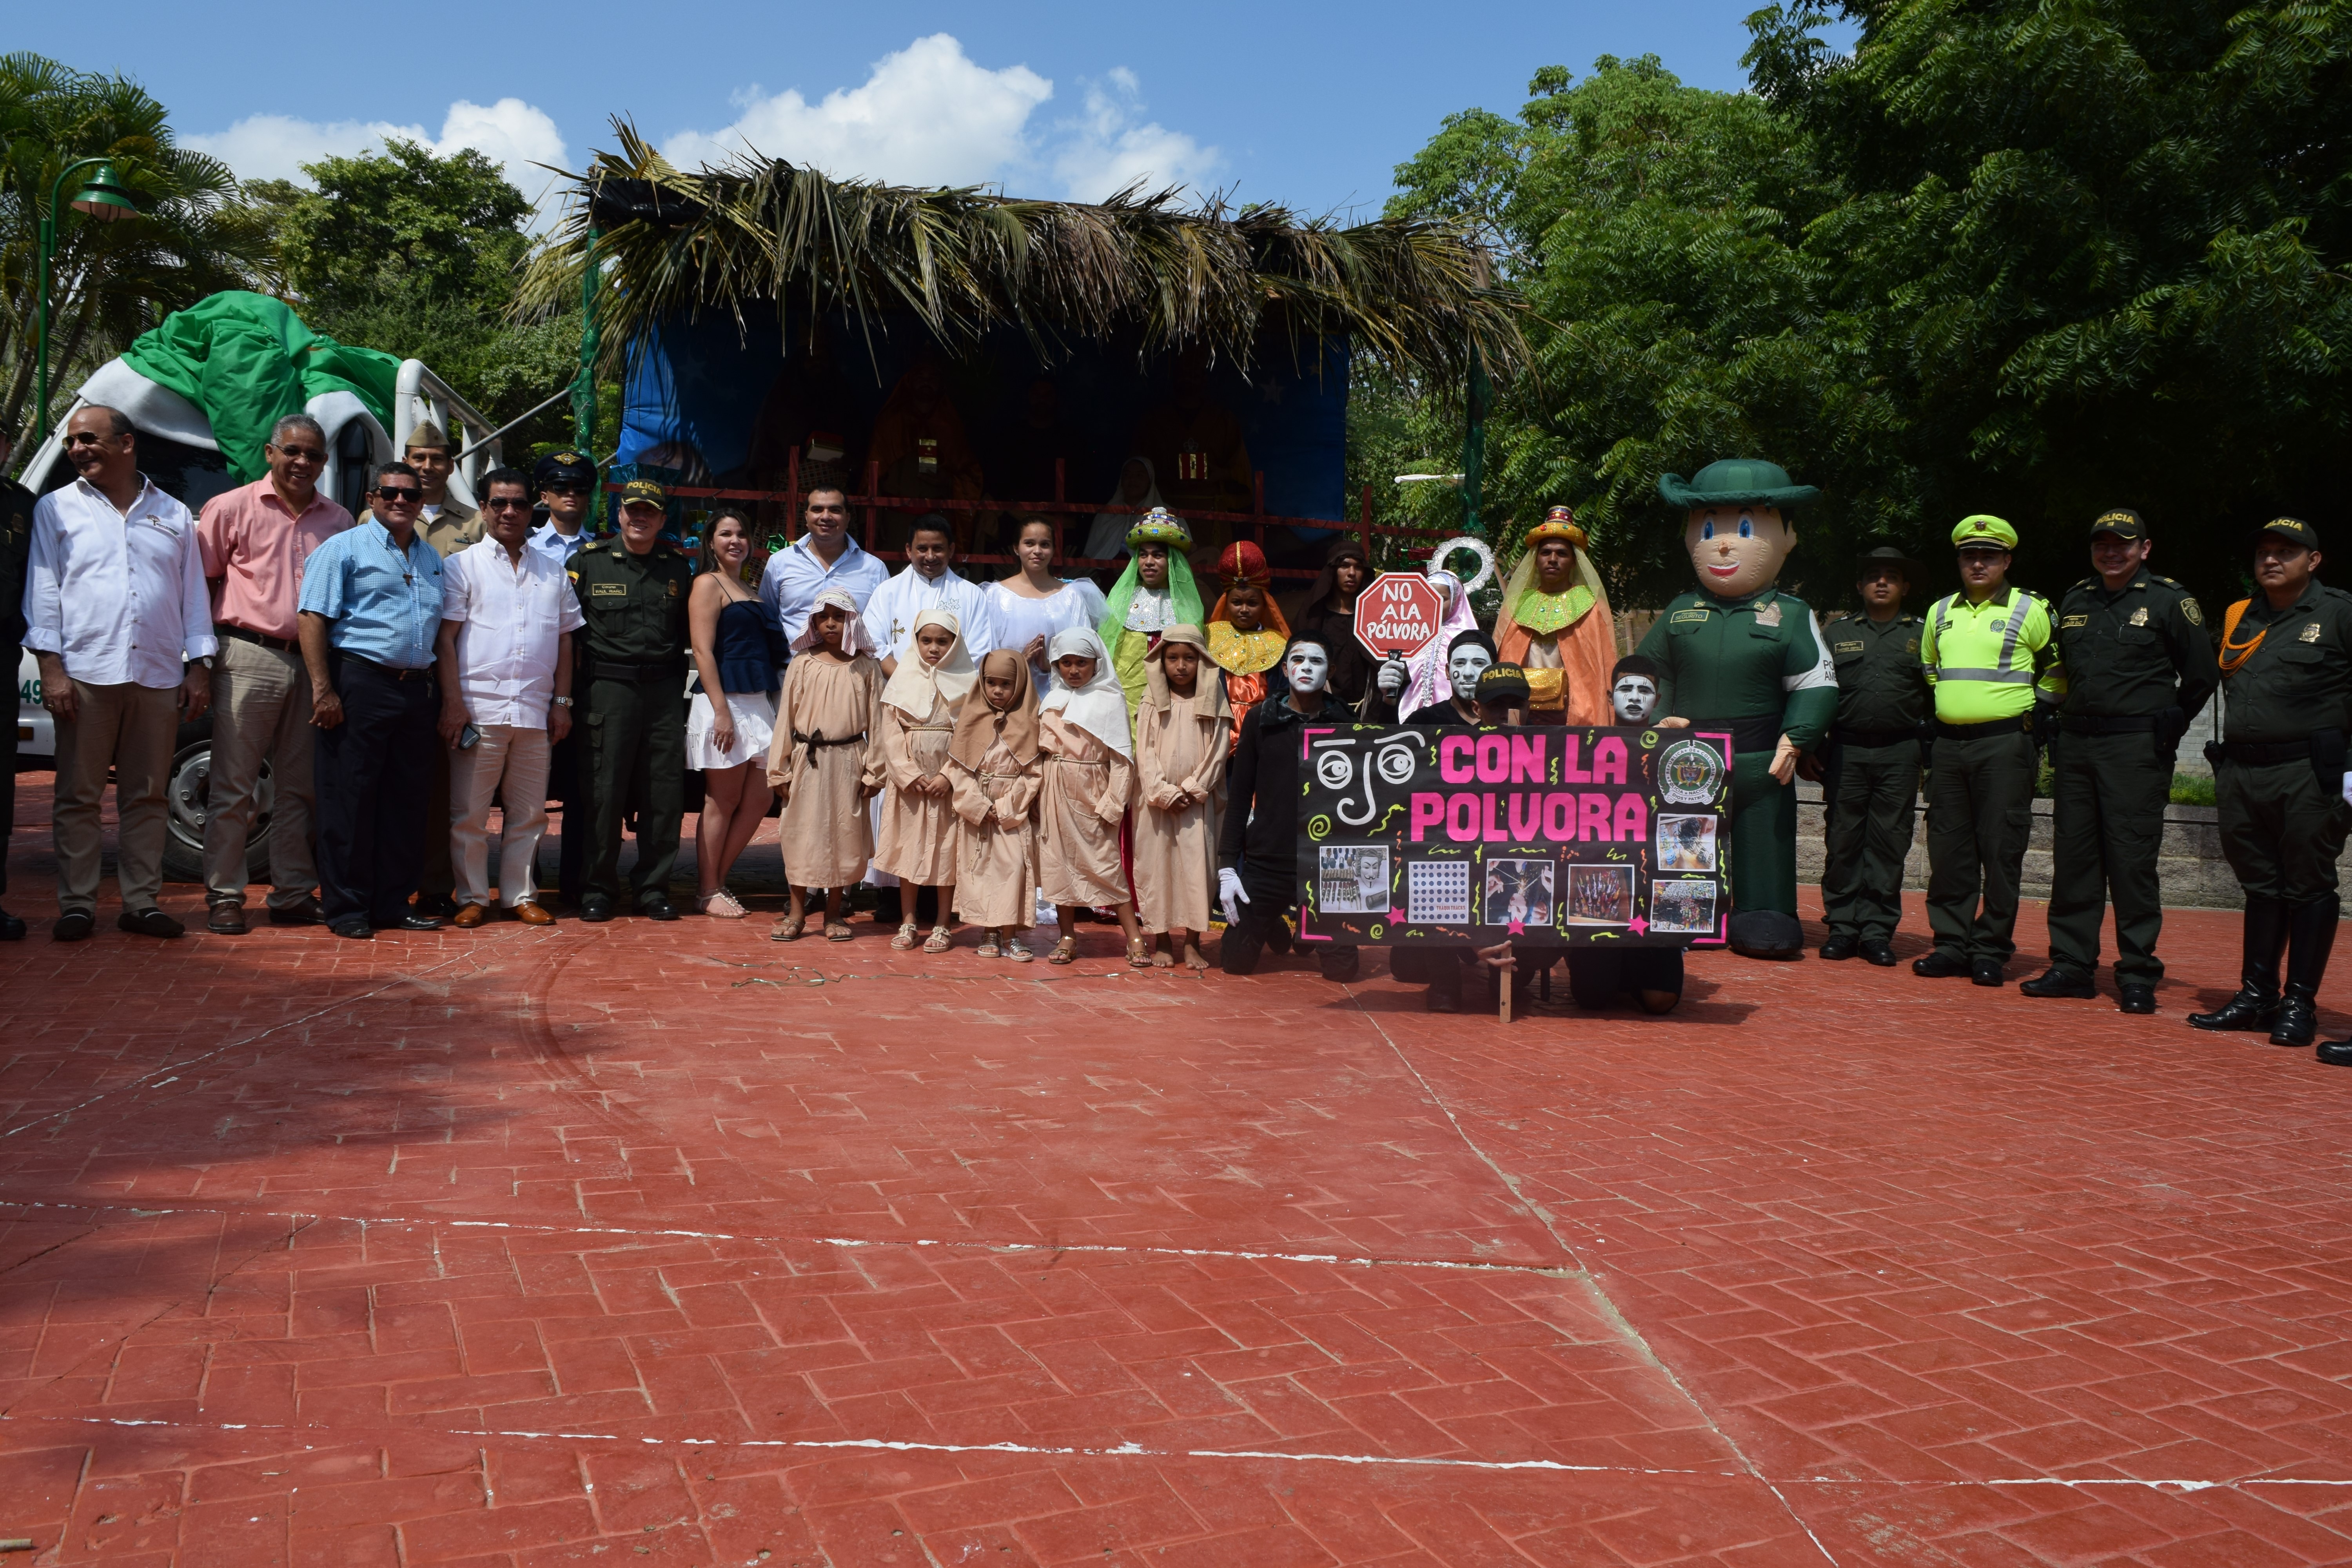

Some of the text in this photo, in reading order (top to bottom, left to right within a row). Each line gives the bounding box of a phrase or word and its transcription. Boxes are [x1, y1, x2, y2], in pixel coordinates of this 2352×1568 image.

[626, 481, 662, 496] POLICIA
[2094, 513, 2134, 526] POLICIA
[1382, 582, 1412, 602] NO
[1381, 603, 1422, 620] A LA
[1367, 619, 1430, 641] PÓLVORA
[1482, 668, 1523, 682] POLICIA
[1440, 734, 1546, 784] CON
[1564, 734, 1628, 784] LA
[1666, 750, 1684, 774] REPUBLICA
[1701, 752, 1716, 777] COLOMBIA
[1667, 779, 1712, 795] POLICIA NACIONAL
[1411, 792, 1647, 842] POLVORA
